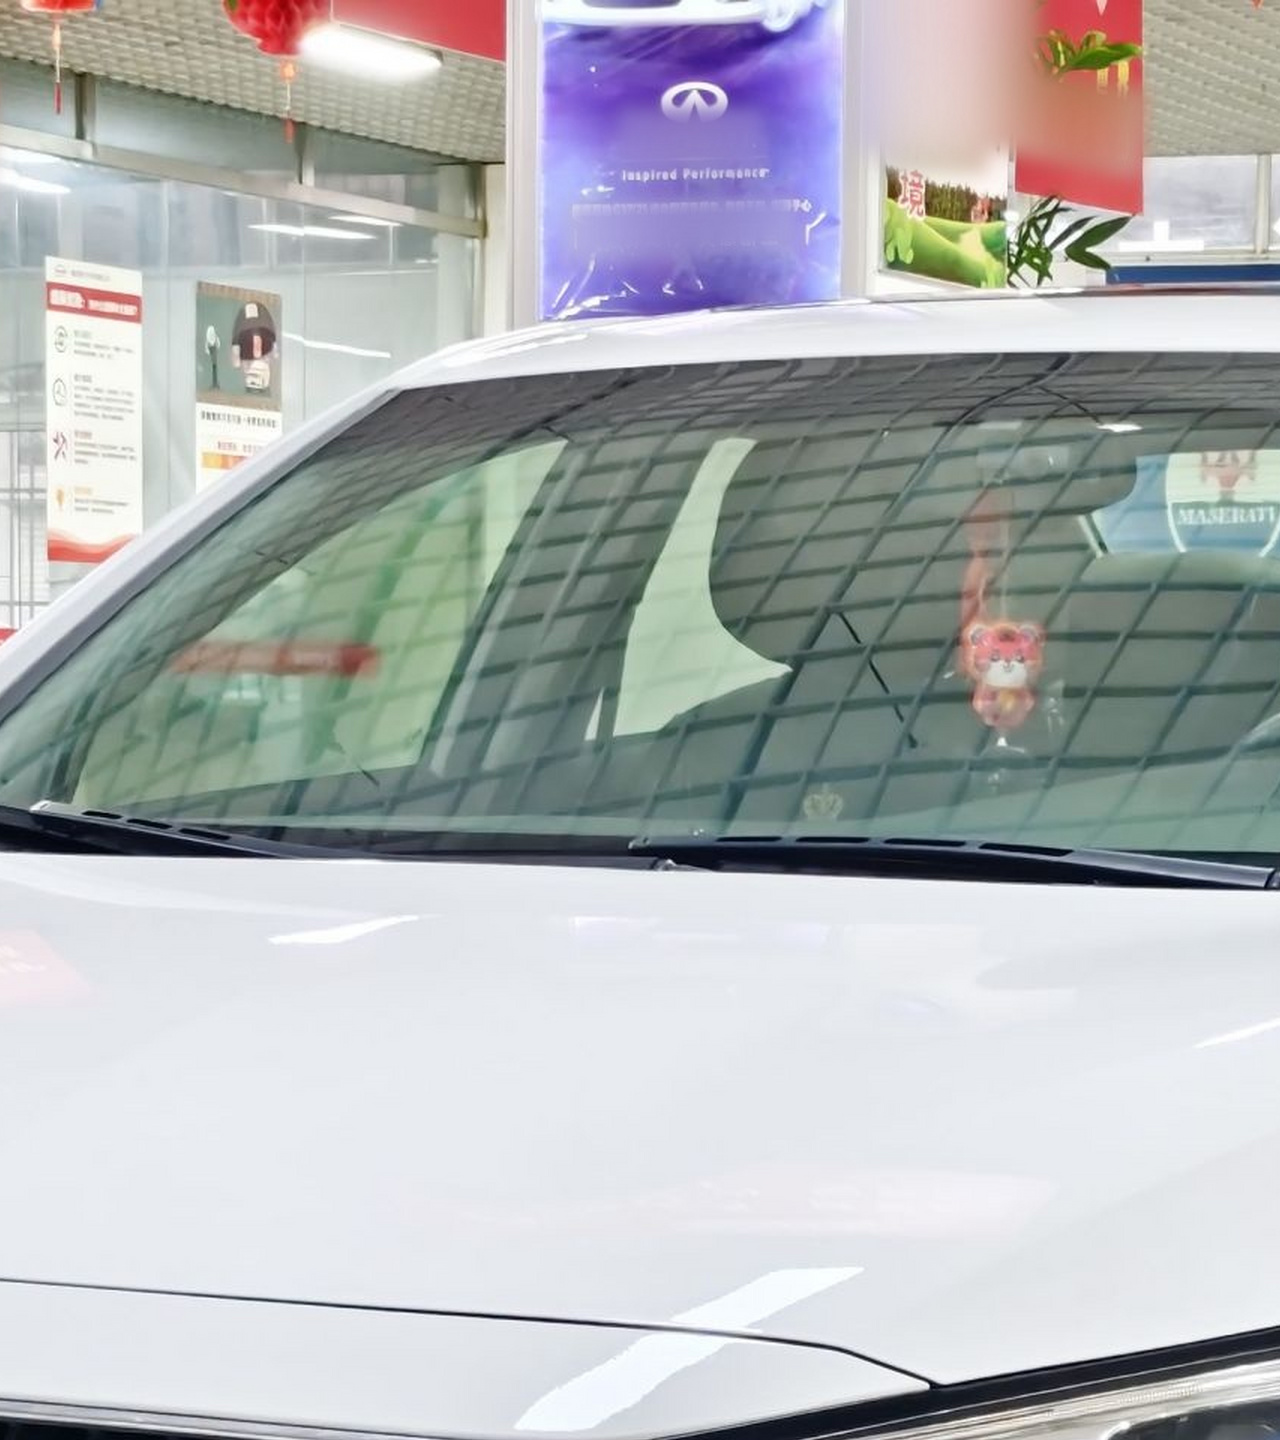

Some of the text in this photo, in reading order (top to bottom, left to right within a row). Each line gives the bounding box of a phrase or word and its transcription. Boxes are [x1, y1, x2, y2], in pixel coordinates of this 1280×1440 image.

[621, 166, 766, 183] Inspired Performance
[1177, 504, 1276, 526] MASERATI
